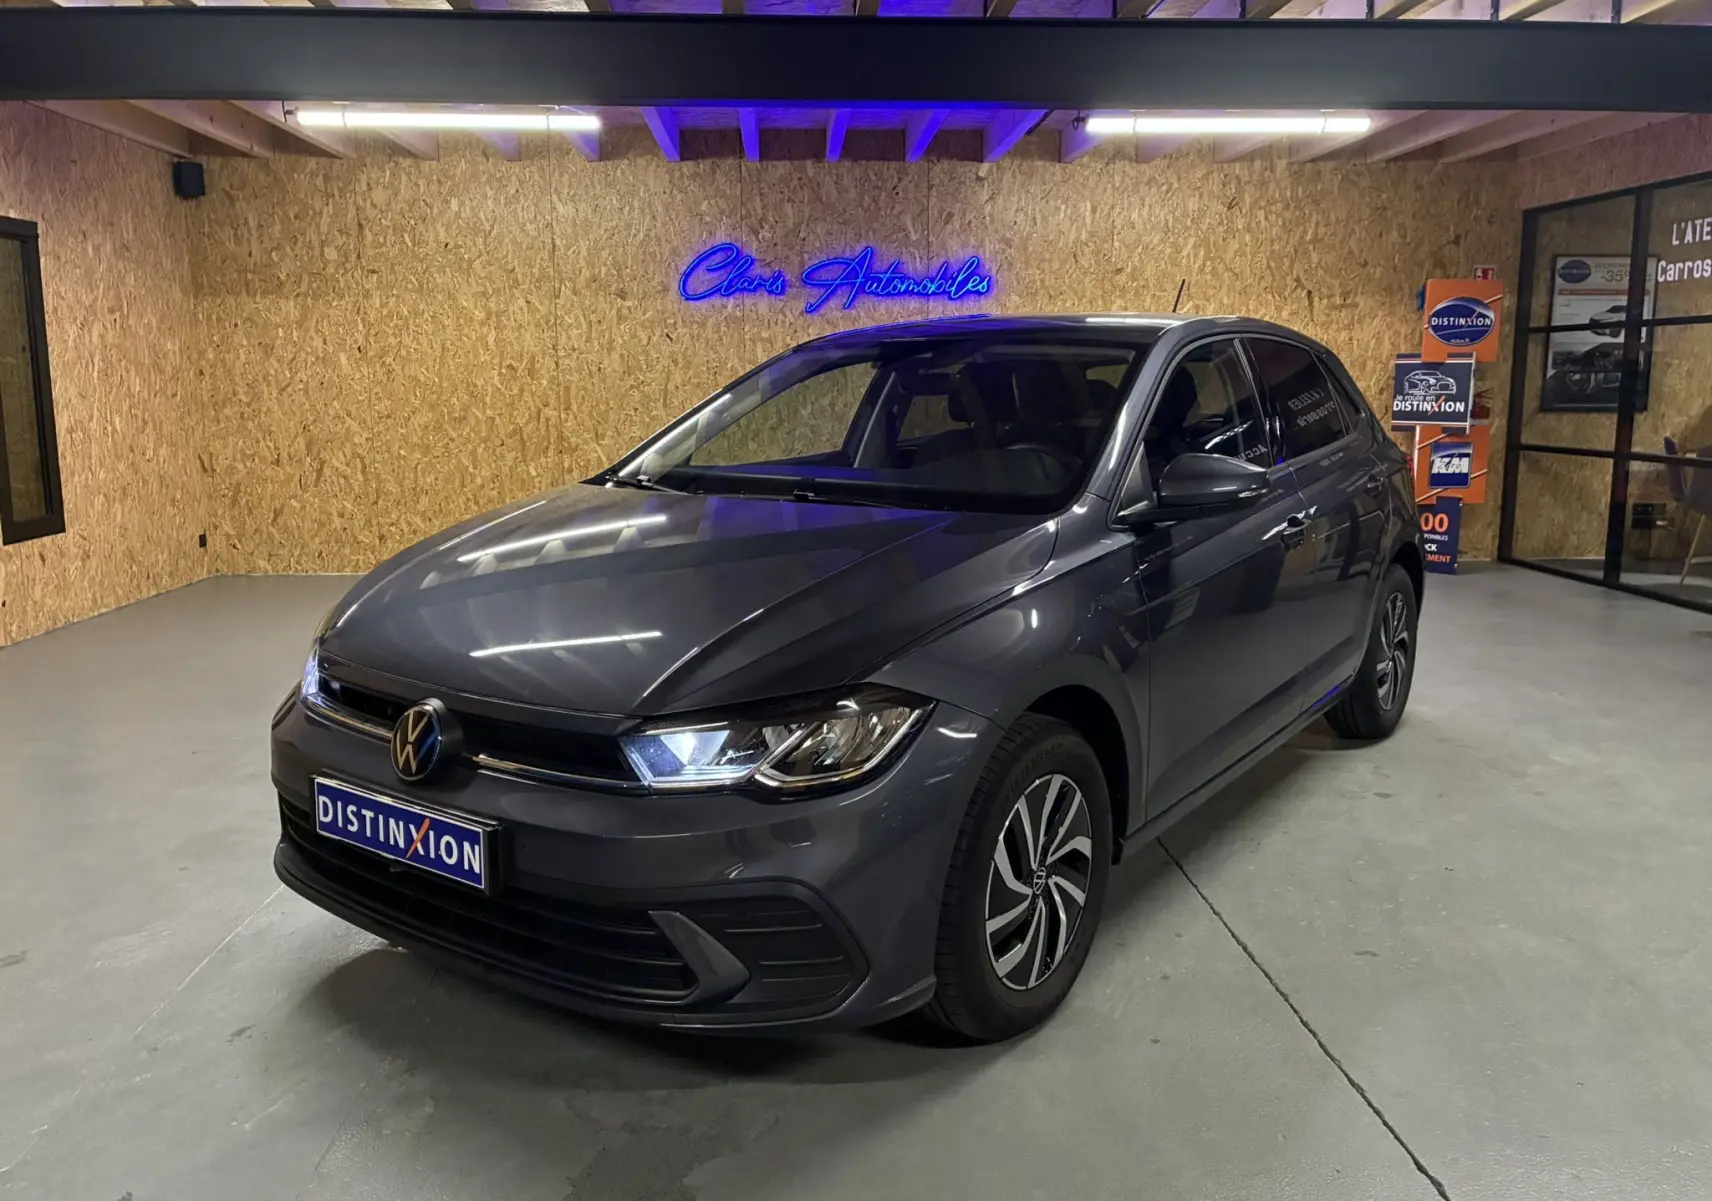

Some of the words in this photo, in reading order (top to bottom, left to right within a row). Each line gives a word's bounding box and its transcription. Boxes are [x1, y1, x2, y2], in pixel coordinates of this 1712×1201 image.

[1672, 217, 1712, 246] L'ATE
[801, 245, 992, 314] Automobiles
[1657, 258, 1712, 283] Carros
[1431, 317, 1491, 326] DISTINXION
[1393, 396, 1465, 415] DISTINXION
[318, 794, 480, 875] DISTINXION
